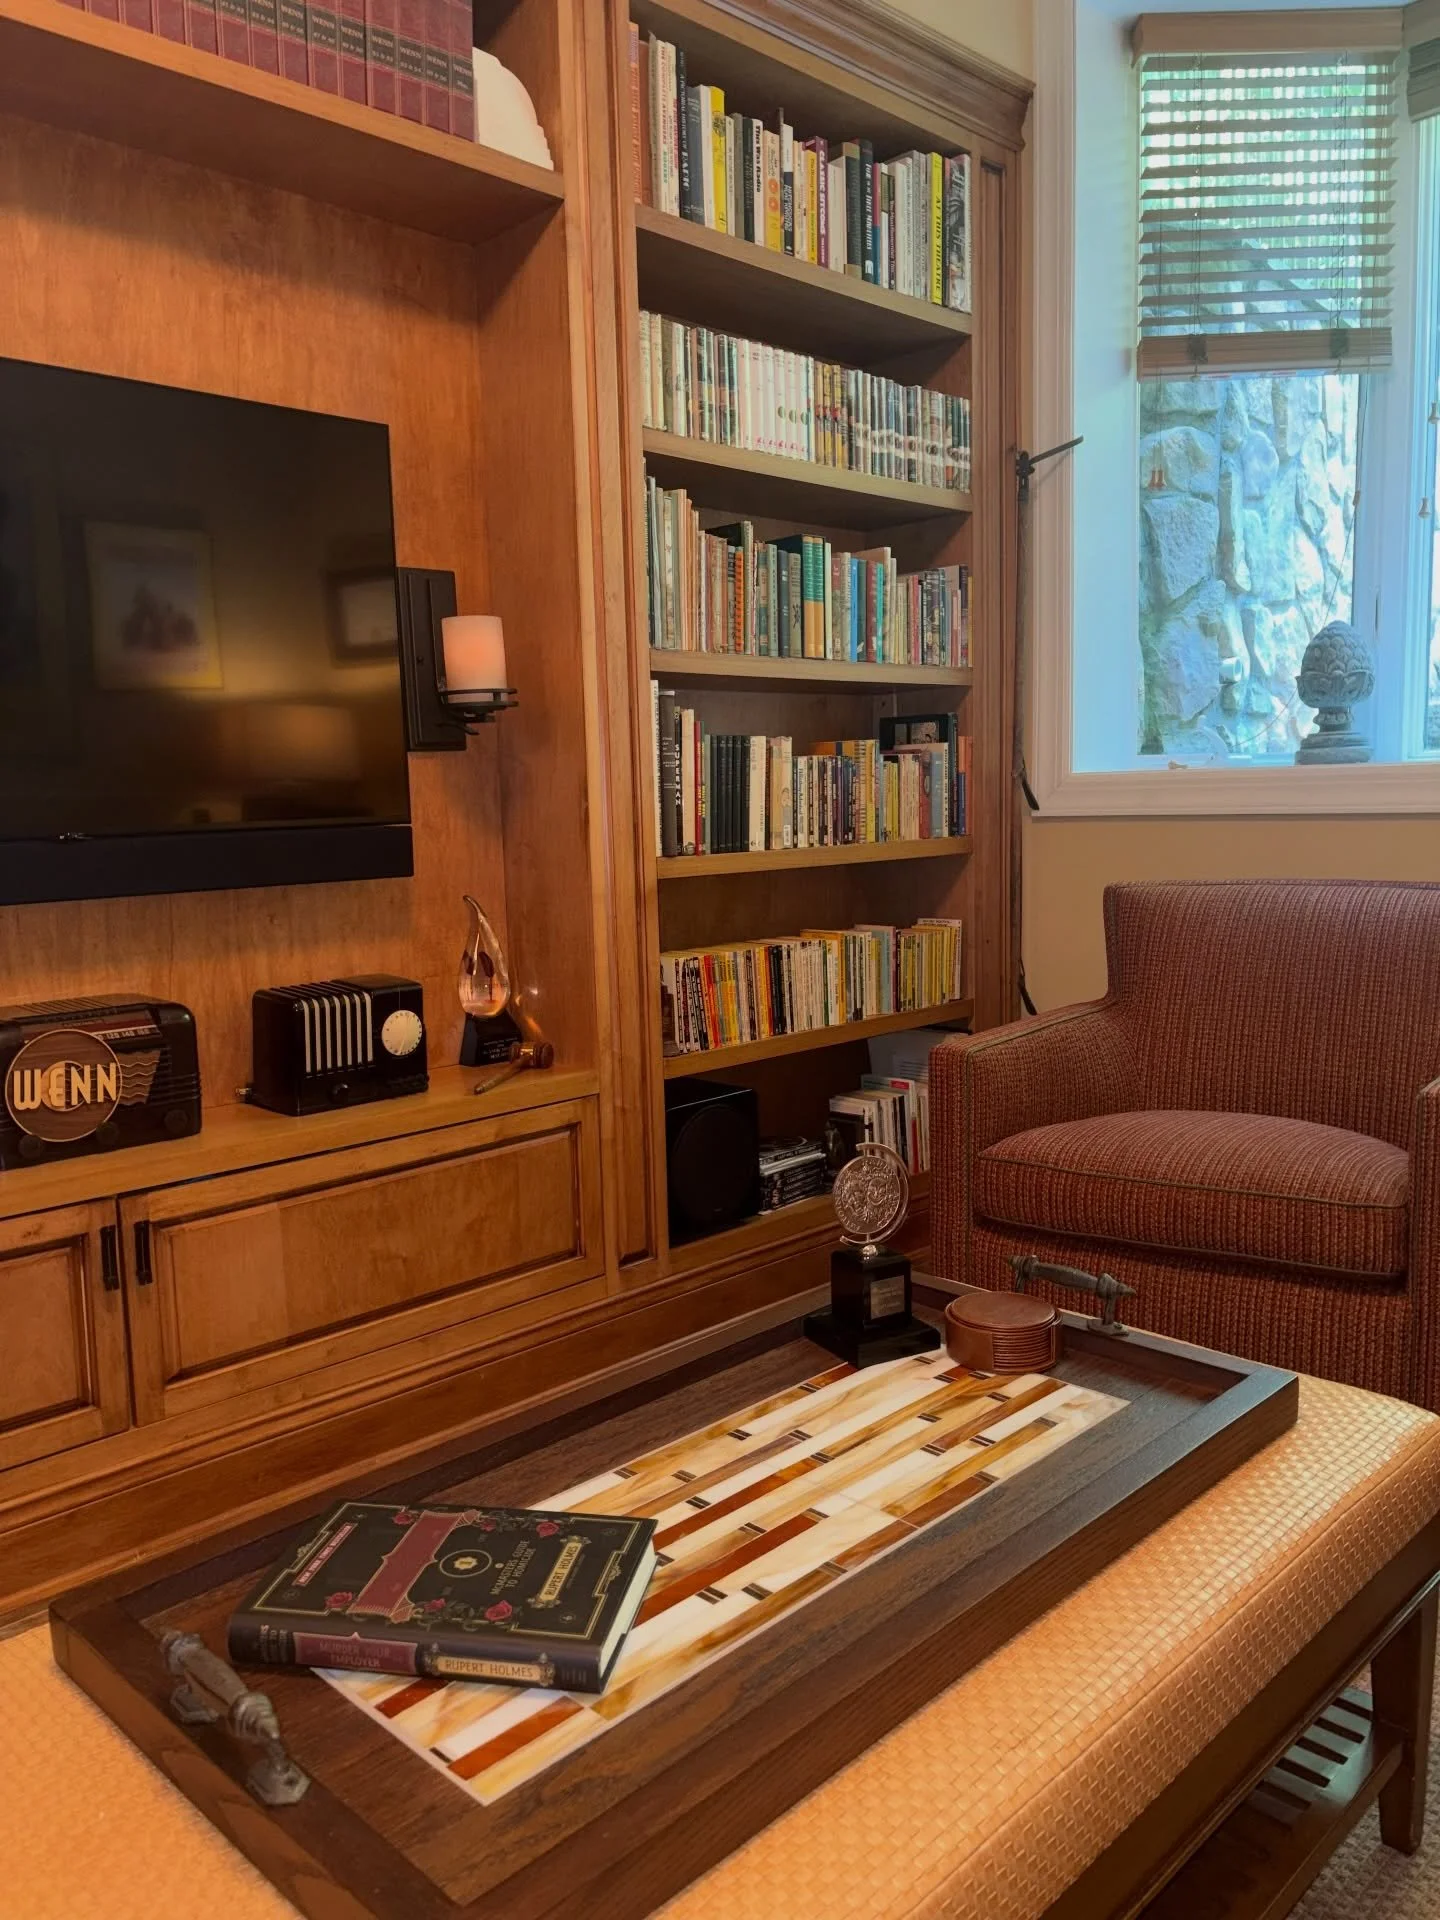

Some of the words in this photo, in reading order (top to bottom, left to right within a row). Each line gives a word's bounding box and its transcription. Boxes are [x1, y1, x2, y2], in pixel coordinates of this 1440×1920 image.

[681, 151, 690, 191] RADIO
[13, 1060, 117, 1111] WENN
[512, 1540, 530, 1560] GUIDE
[511, 1548, 537, 1578] HOMICIDE
[544, 1571, 565, 1597] RUPERT
[561, 1544, 579, 1570] HOLMES
[504, 1579, 519, 1589] TO
[319, 1640, 360, 1655] MURDER
[330, 1653, 381, 1668] EMPLOYER
[444, 1659, 485, 1673] RUPERT
[489, 1664, 534, 1679] HOLMES
